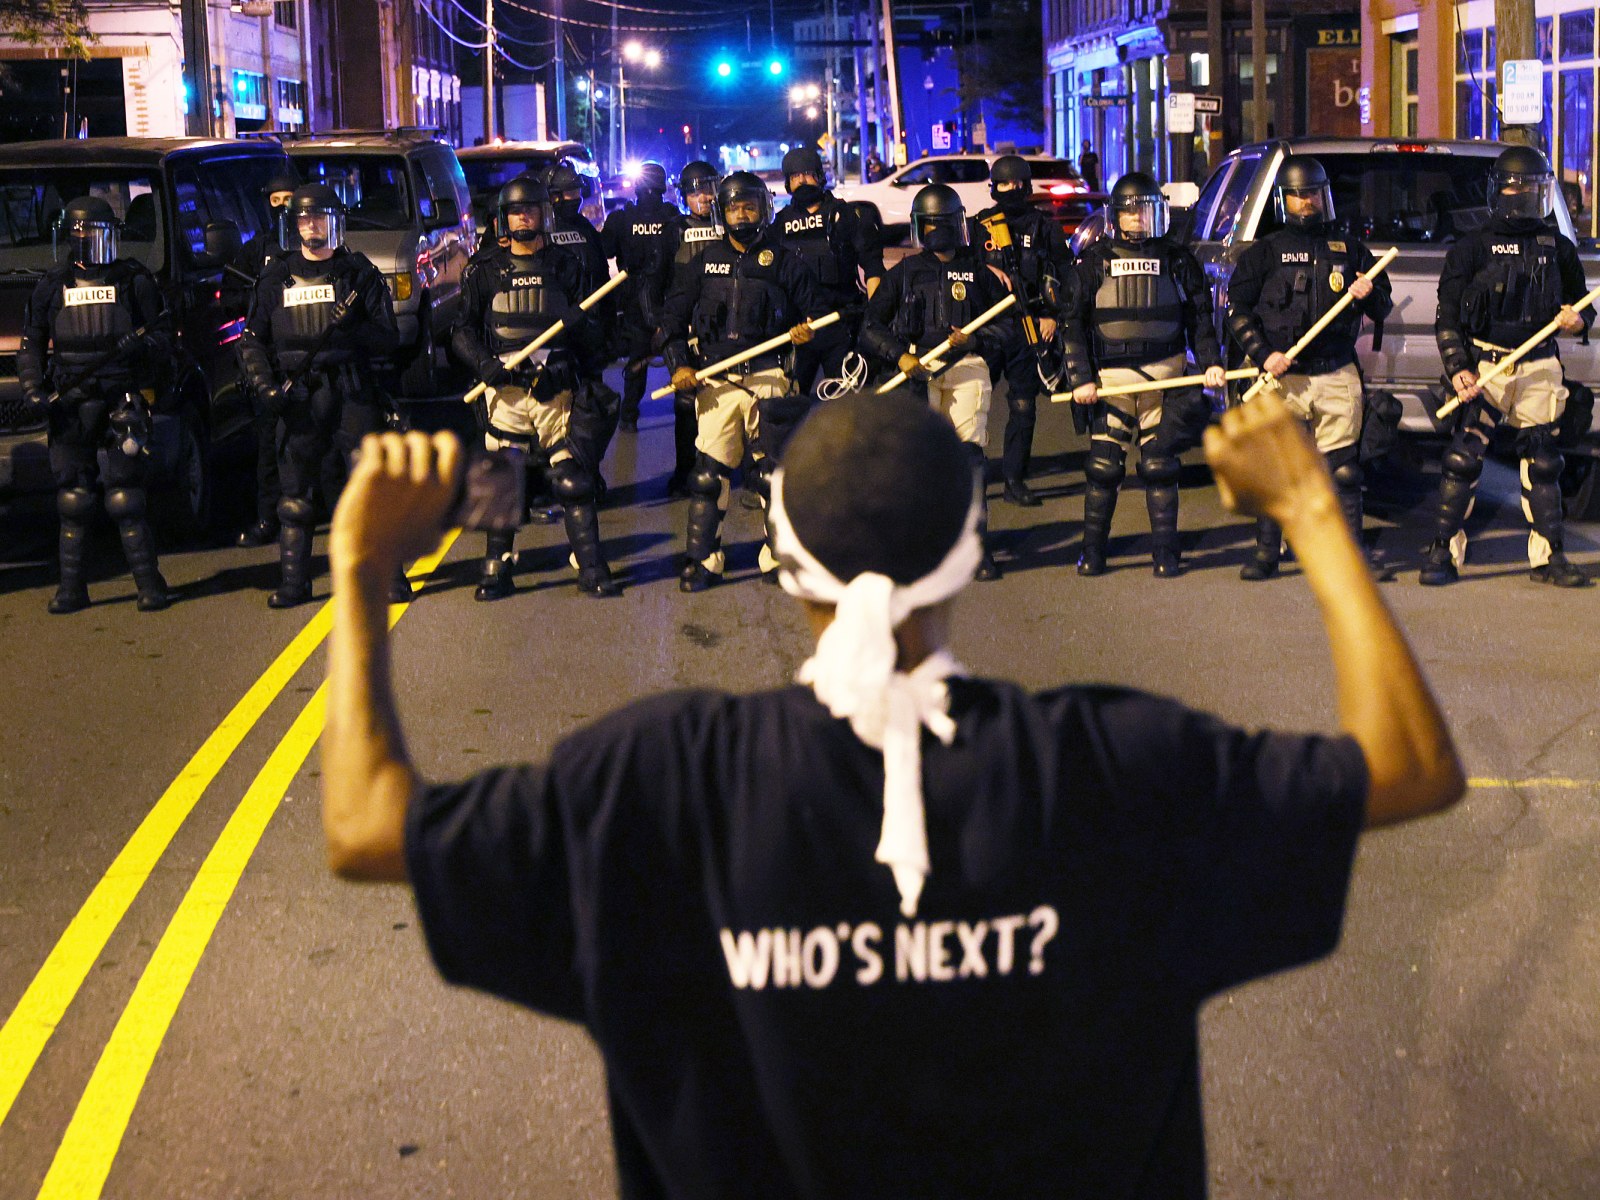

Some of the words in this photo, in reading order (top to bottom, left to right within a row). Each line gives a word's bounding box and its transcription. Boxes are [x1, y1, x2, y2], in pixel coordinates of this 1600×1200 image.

[1506, 65, 1515, 83] 2
[1170, 95, 1176, 108] 2
[784, 214, 824, 234] POLICE
[686, 229, 720, 239] POLIC
[1491, 243, 1520, 255] POLICE
[704, 262, 731, 274] POLICE
[1113, 261, 1158, 272] POLICE
[512, 276, 542, 287] POLICE
[947, 271, 974, 282] POLICE
[67, 289, 113, 302] POLICE
[719, 921, 884, 991] WHO'S
[894, 904, 1060, 982] NEXT?
